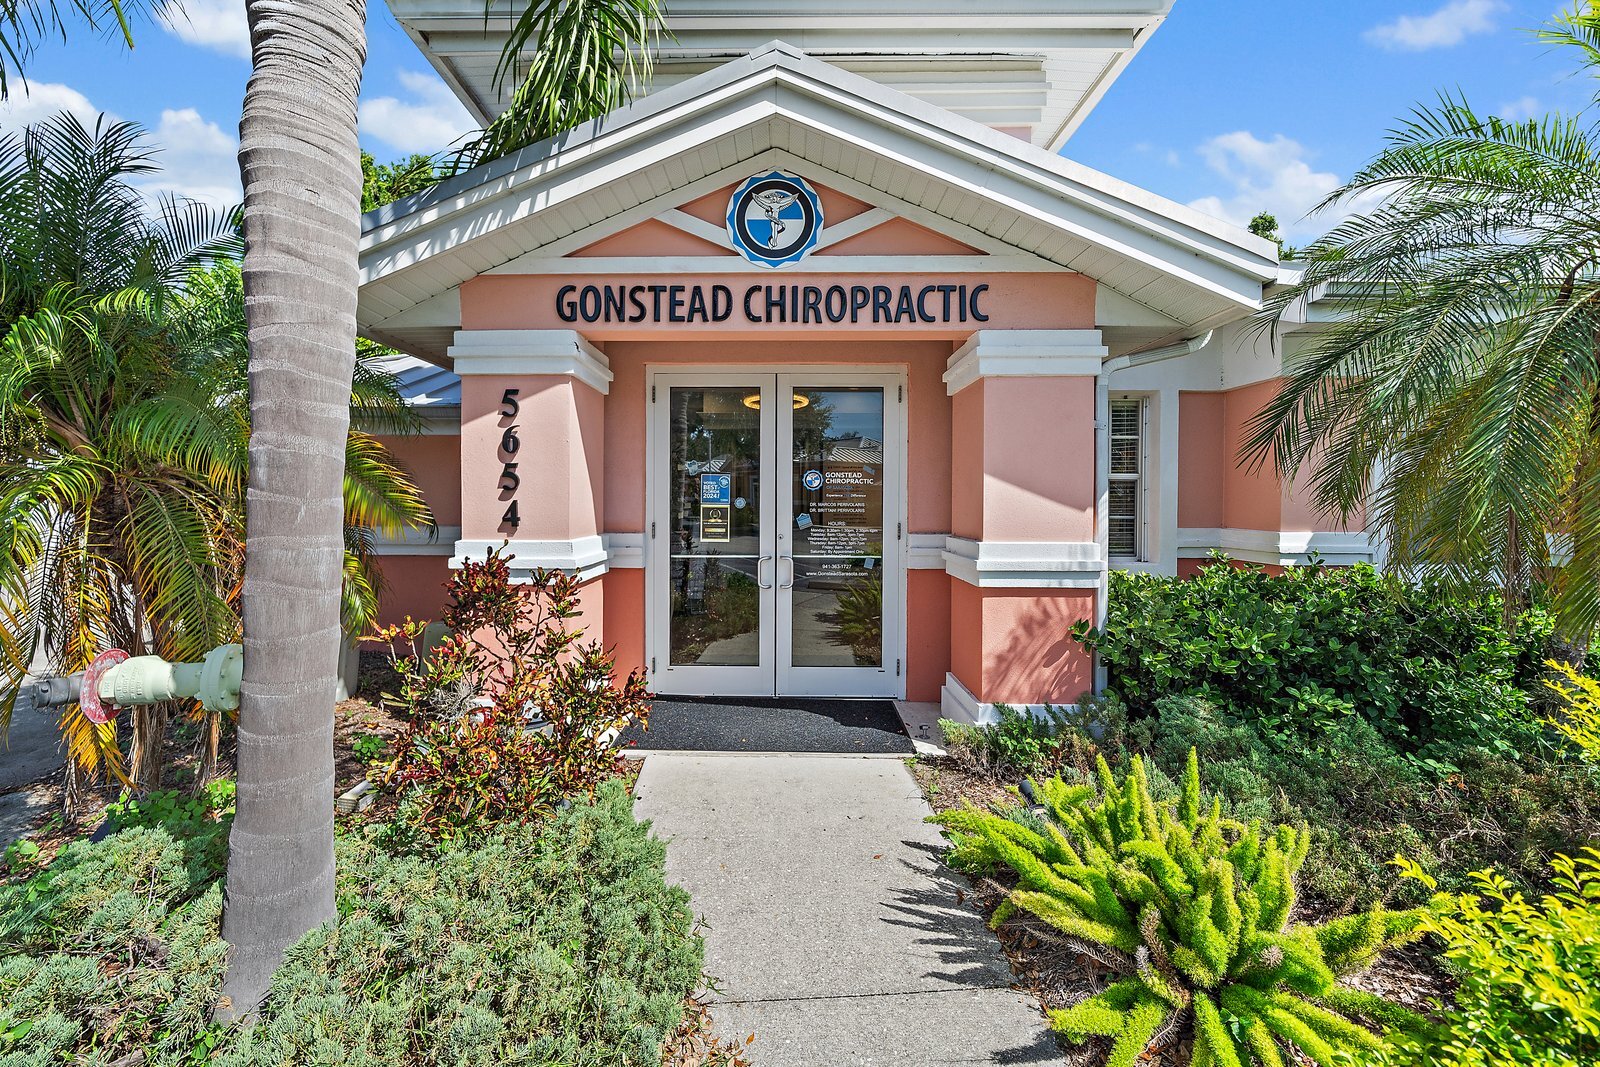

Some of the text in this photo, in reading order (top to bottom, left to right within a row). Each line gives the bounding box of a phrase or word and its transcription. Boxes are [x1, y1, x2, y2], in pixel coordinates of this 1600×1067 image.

[556, 284, 990, 324] GONSTEAD CHIROPRACTIC
[501, 389, 521, 527] 5654
